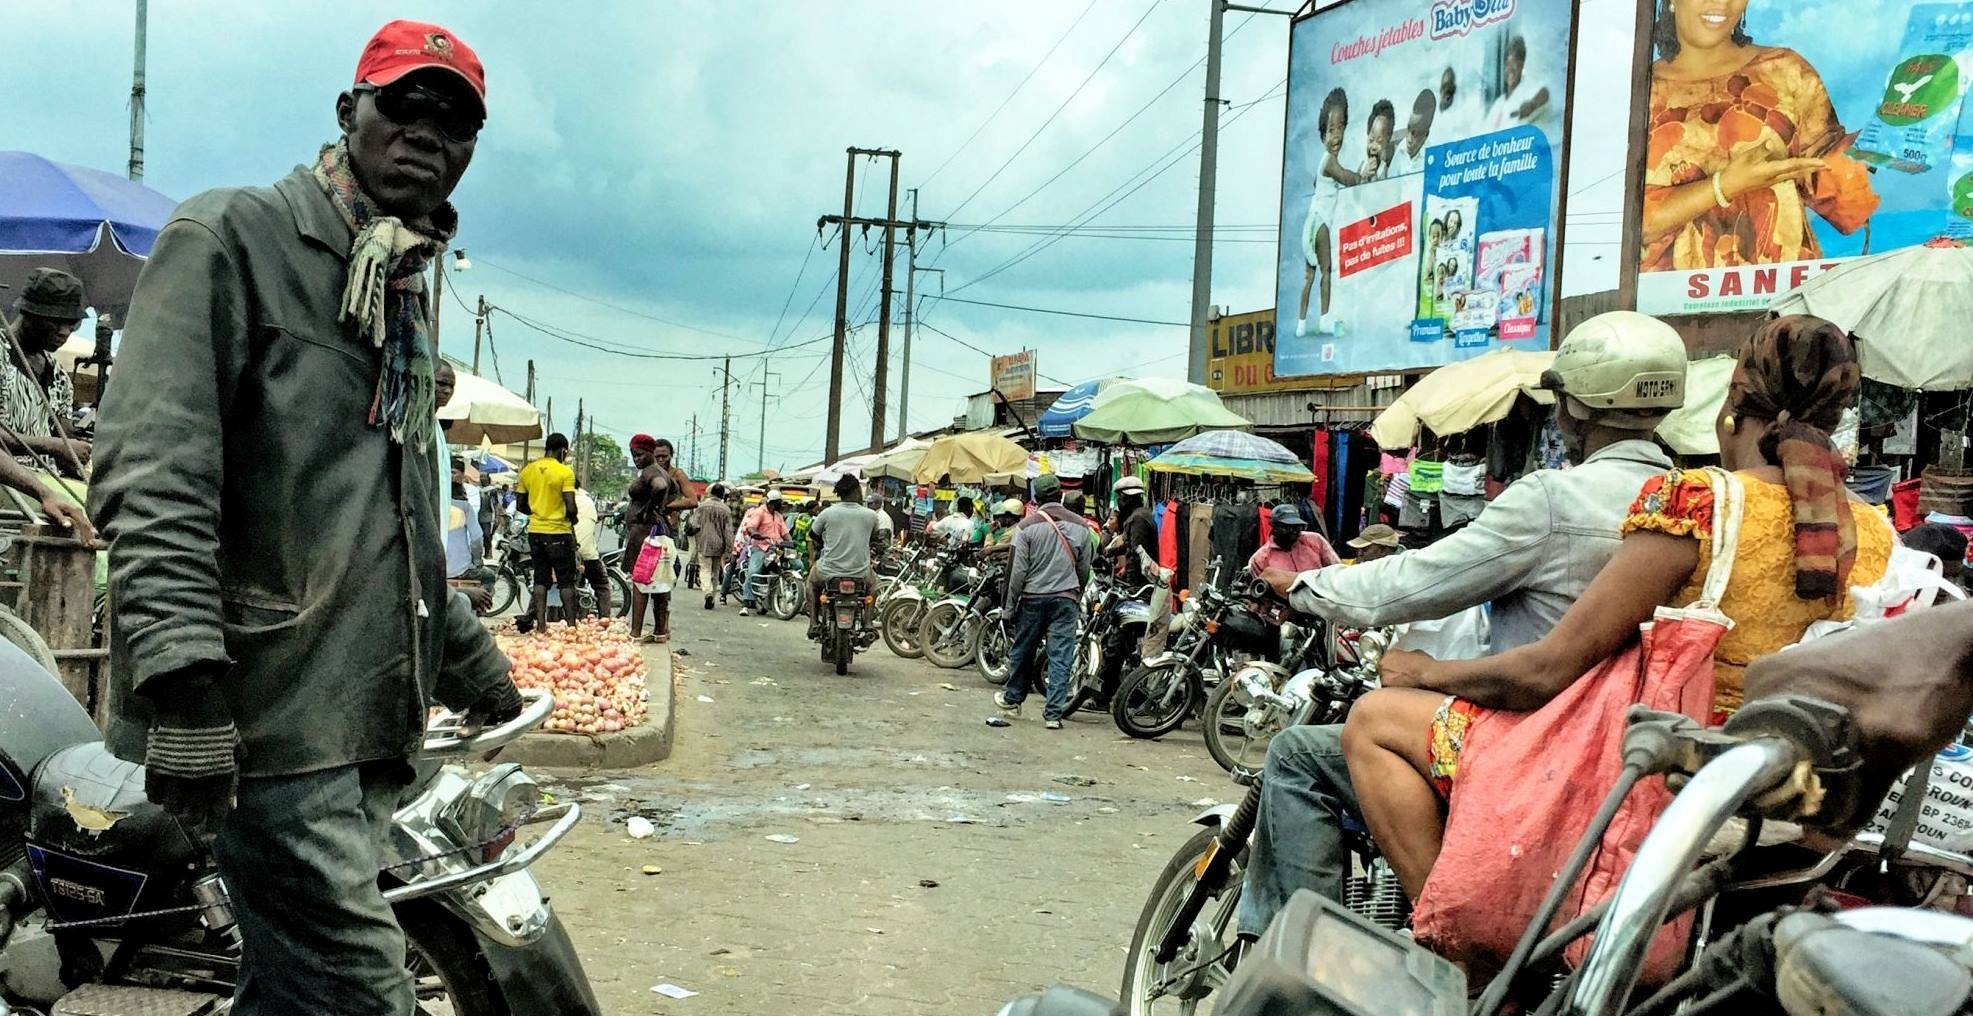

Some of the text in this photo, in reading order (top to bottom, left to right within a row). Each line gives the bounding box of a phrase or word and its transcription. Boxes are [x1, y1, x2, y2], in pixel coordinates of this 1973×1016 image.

[1331, 36, 1375, 65] Couches
[1374, 19, 1425, 58] jetables
[1444, 136, 1535, 168] Source de bonheur
[1438, 153, 1538, 193] pour toute la famille
[1343, 241, 1358, 253] Pas
[1344, 255, 1359, 270] pas
[1360, 251, 1371, 262] de
[1234, 364, 1258, 386] DU
[1921, 804, 1940, 818] BP
